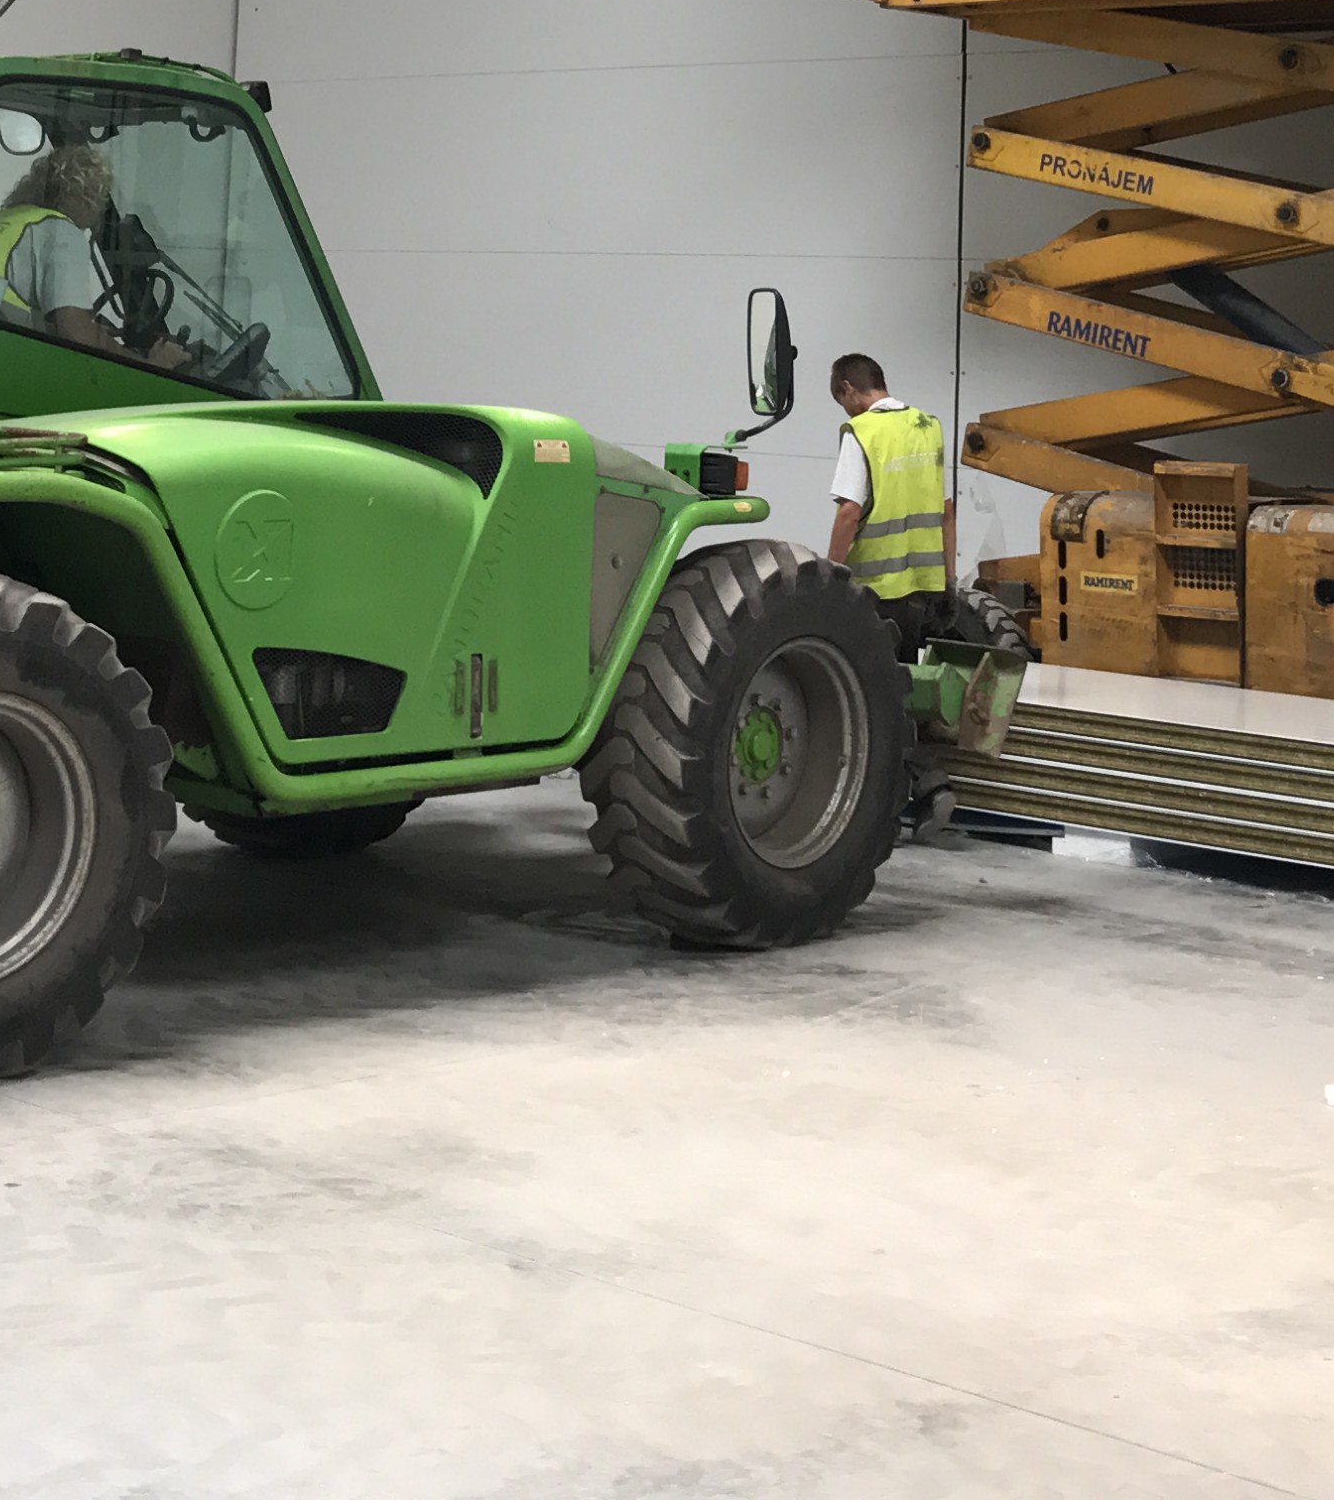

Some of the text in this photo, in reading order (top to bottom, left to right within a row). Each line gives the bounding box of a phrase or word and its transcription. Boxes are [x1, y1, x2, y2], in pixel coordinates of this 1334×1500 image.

[1039, 153, 1154, 195] PRONÁJEM
[1047, 311, 1151, 357] RAMIRENT
[1083, 575, 1135, 591] RAMIRENT
